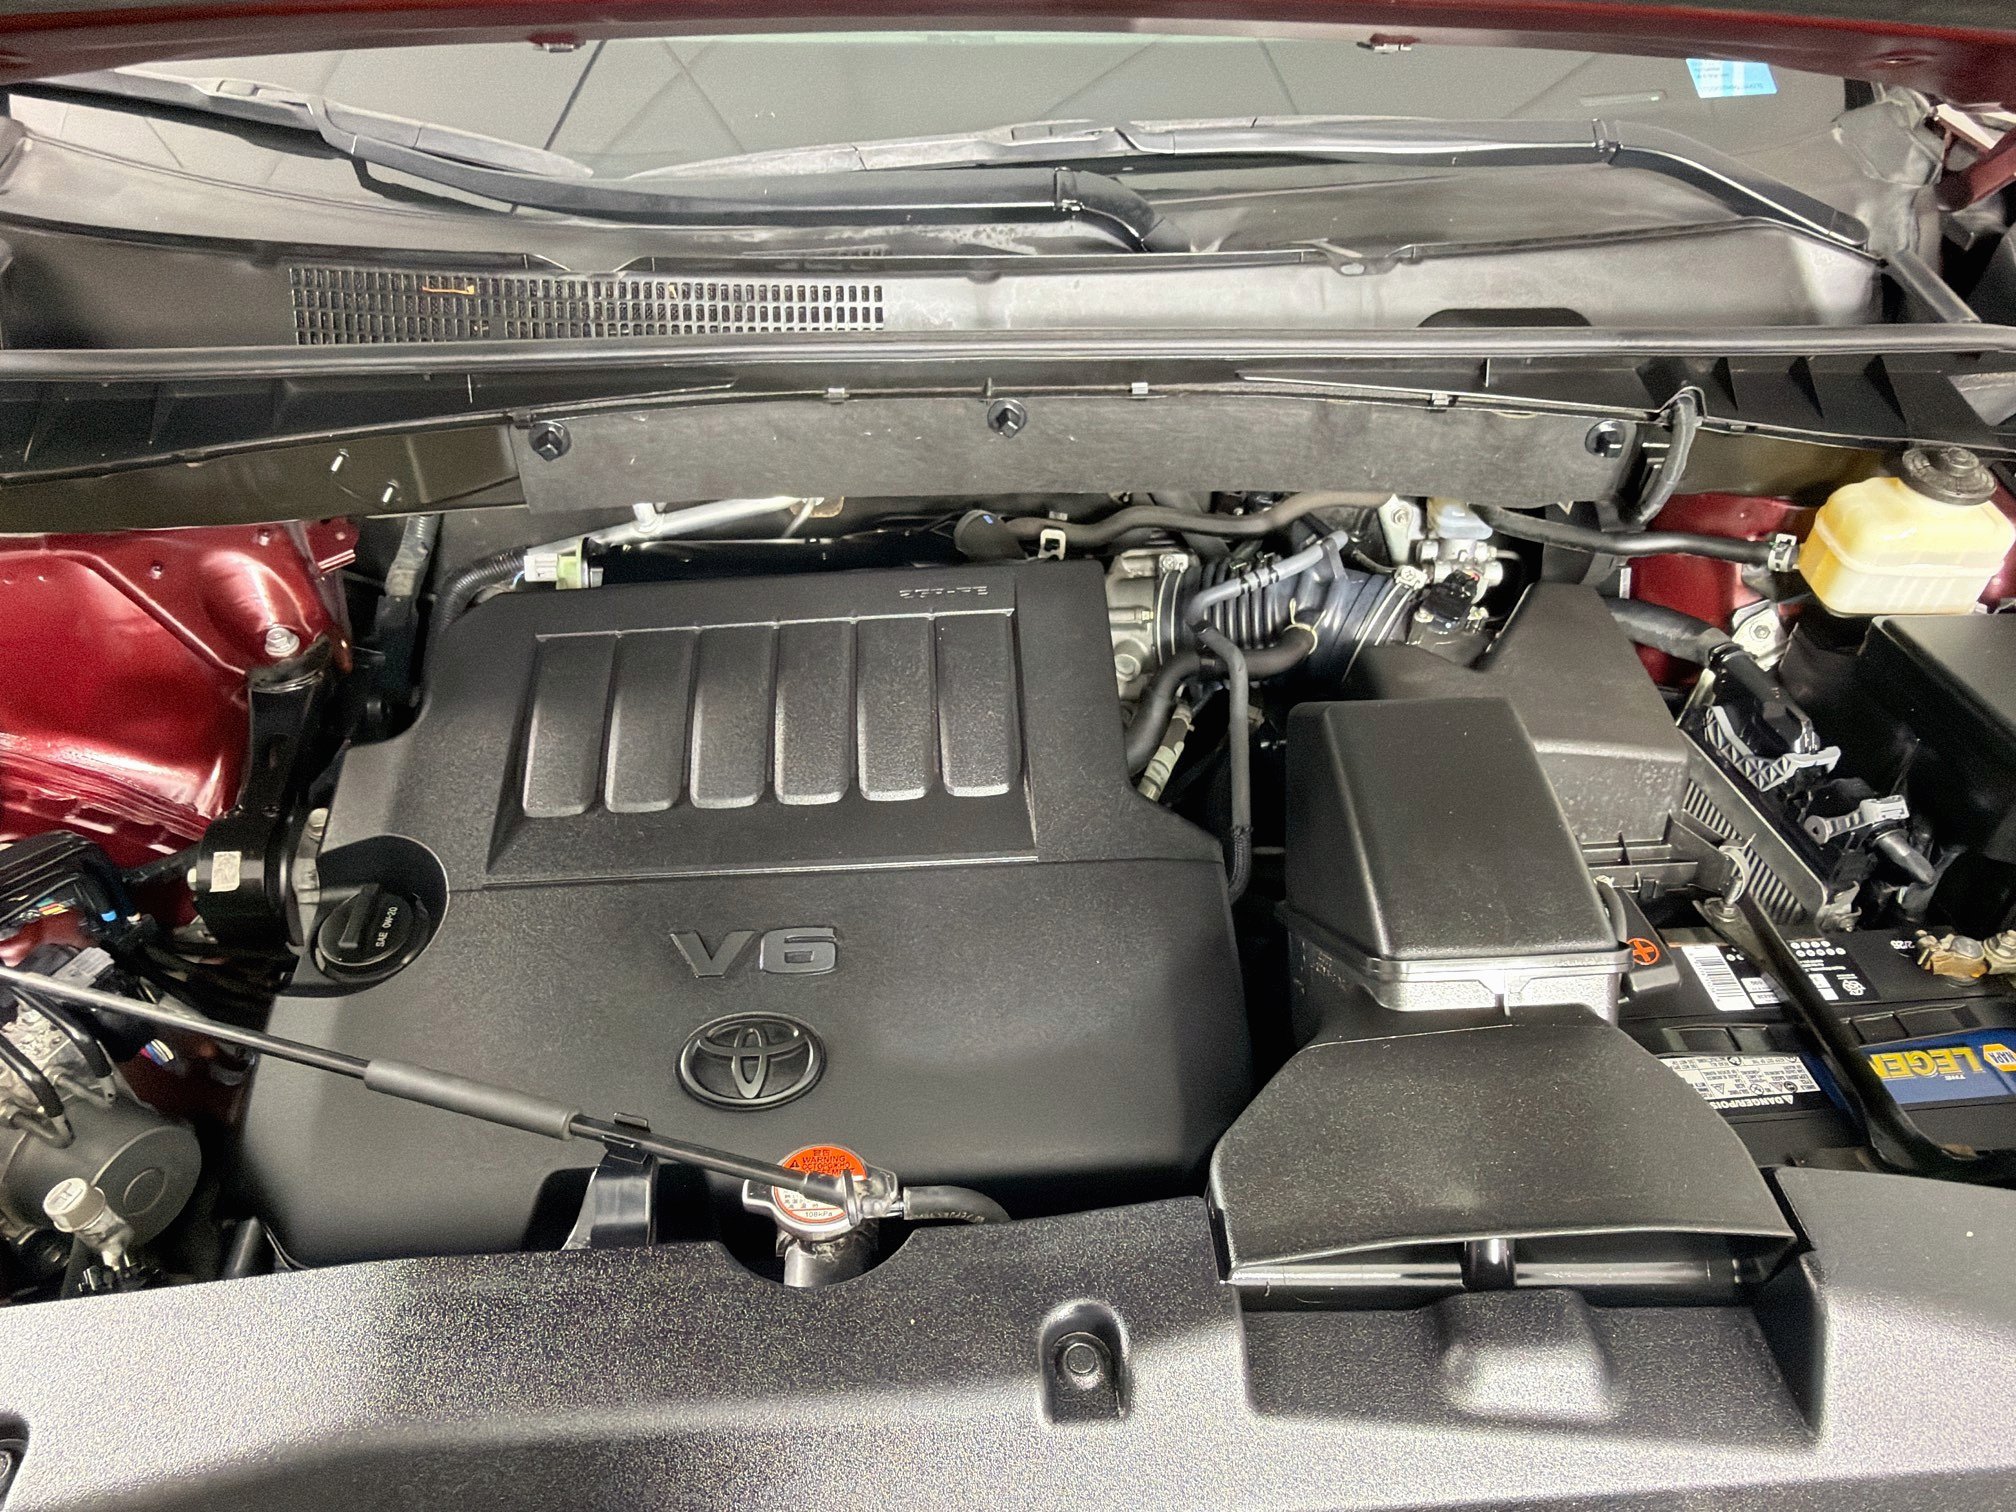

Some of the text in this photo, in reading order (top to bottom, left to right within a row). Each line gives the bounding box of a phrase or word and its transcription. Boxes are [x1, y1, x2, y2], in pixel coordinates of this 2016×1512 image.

[375, 906, 399, 948] SAE 0W-20
[670, 926, 837, 978] V6
[1988, 1052, 2016, 1065] NAPA
[802, 1155, 846, 1164] WARNING
